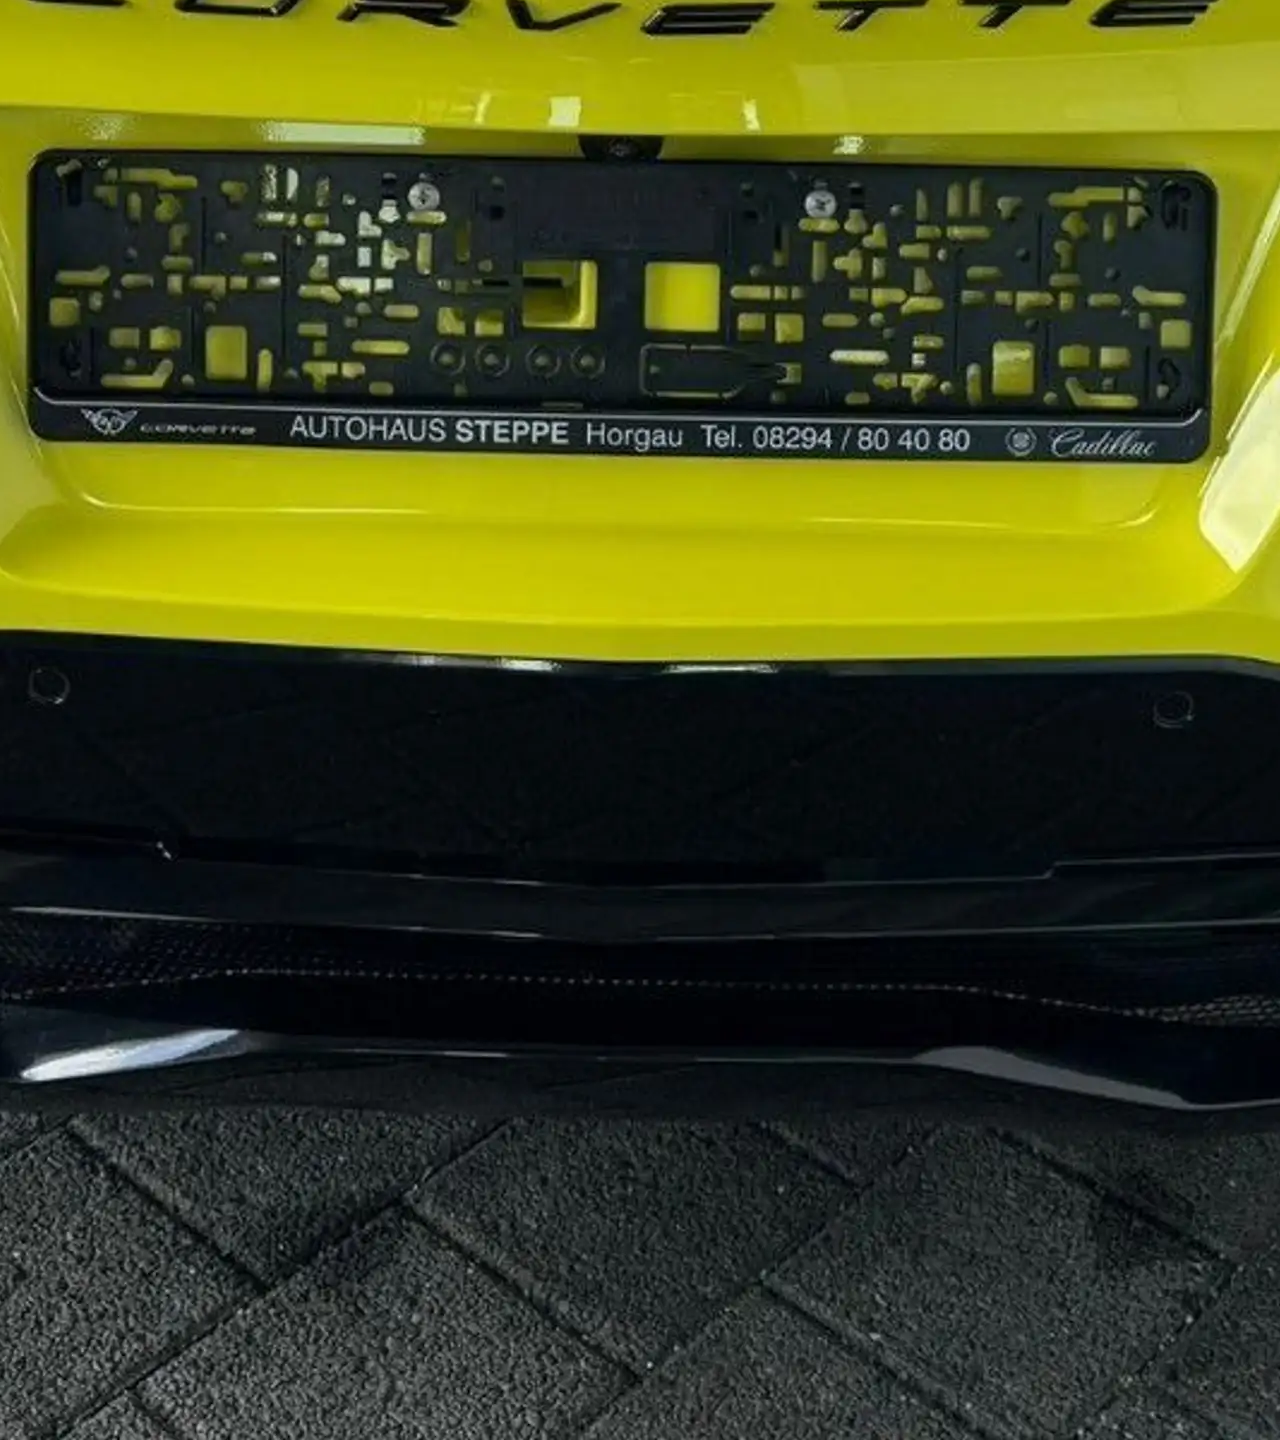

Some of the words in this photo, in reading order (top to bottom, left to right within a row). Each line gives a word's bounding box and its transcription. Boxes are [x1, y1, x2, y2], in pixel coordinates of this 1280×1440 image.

[289, 414, 447, 442] AUTOHAUS
[455, 419, 570, 445] STEPPE
[586, 422, 683, 452] Horgau
[700, 424, 743, 449] Tel.
[752, 426, 833, 450] 08294
[857, 427, 889, 451] 80
[897, 428, 929, 452] 40
[938, 428, 970, 452] 80
[1049, 428, 1158, 458] Cadillac
